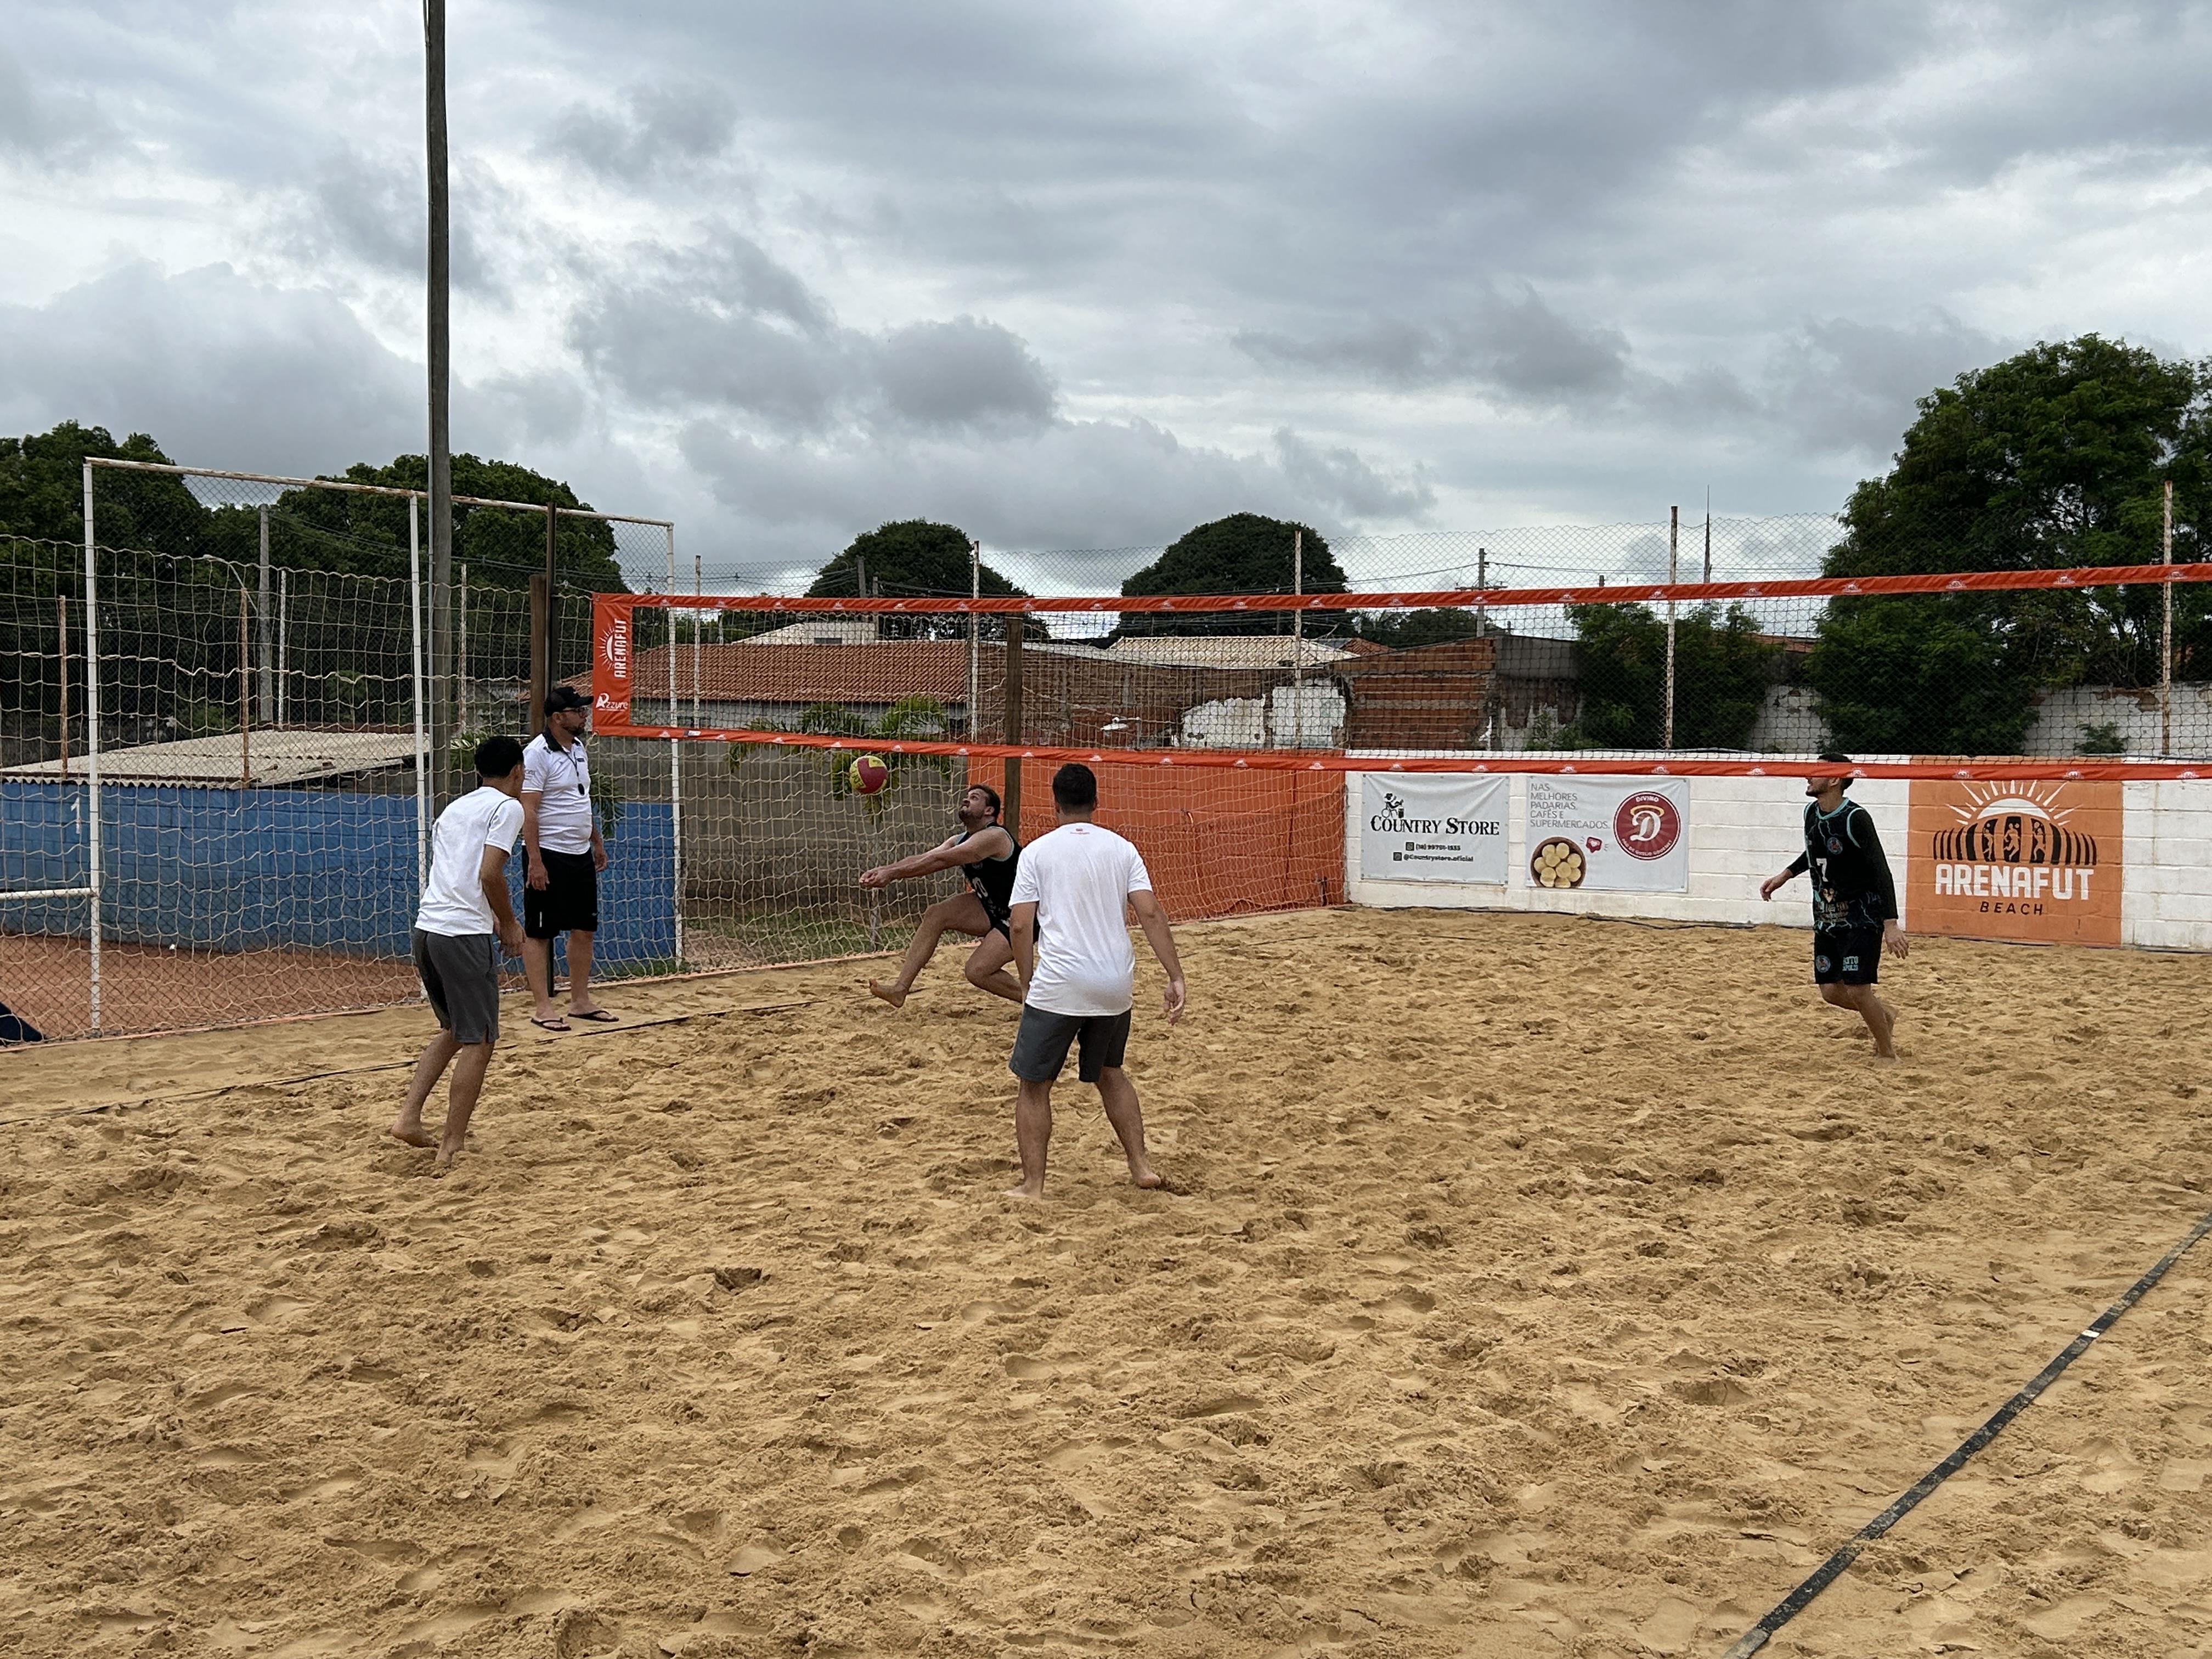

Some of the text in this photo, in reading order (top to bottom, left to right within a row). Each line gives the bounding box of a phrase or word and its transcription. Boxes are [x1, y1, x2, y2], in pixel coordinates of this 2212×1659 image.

[614, 618, 627, 678] ARENAFUT
[1531, 783, 1550, 792] NAS
[1531, 792, 1578, 801] MELHORES
[1531, 809, 1564, 819] CAFÉS E
[1370, 815, 1500, 835] COUNTRY STORE
[1816, 857, 1829, 882] 7
[1935, 863, 2094, 900] ARENAFUT
[1979, 901, 2044, 916] BEACH
